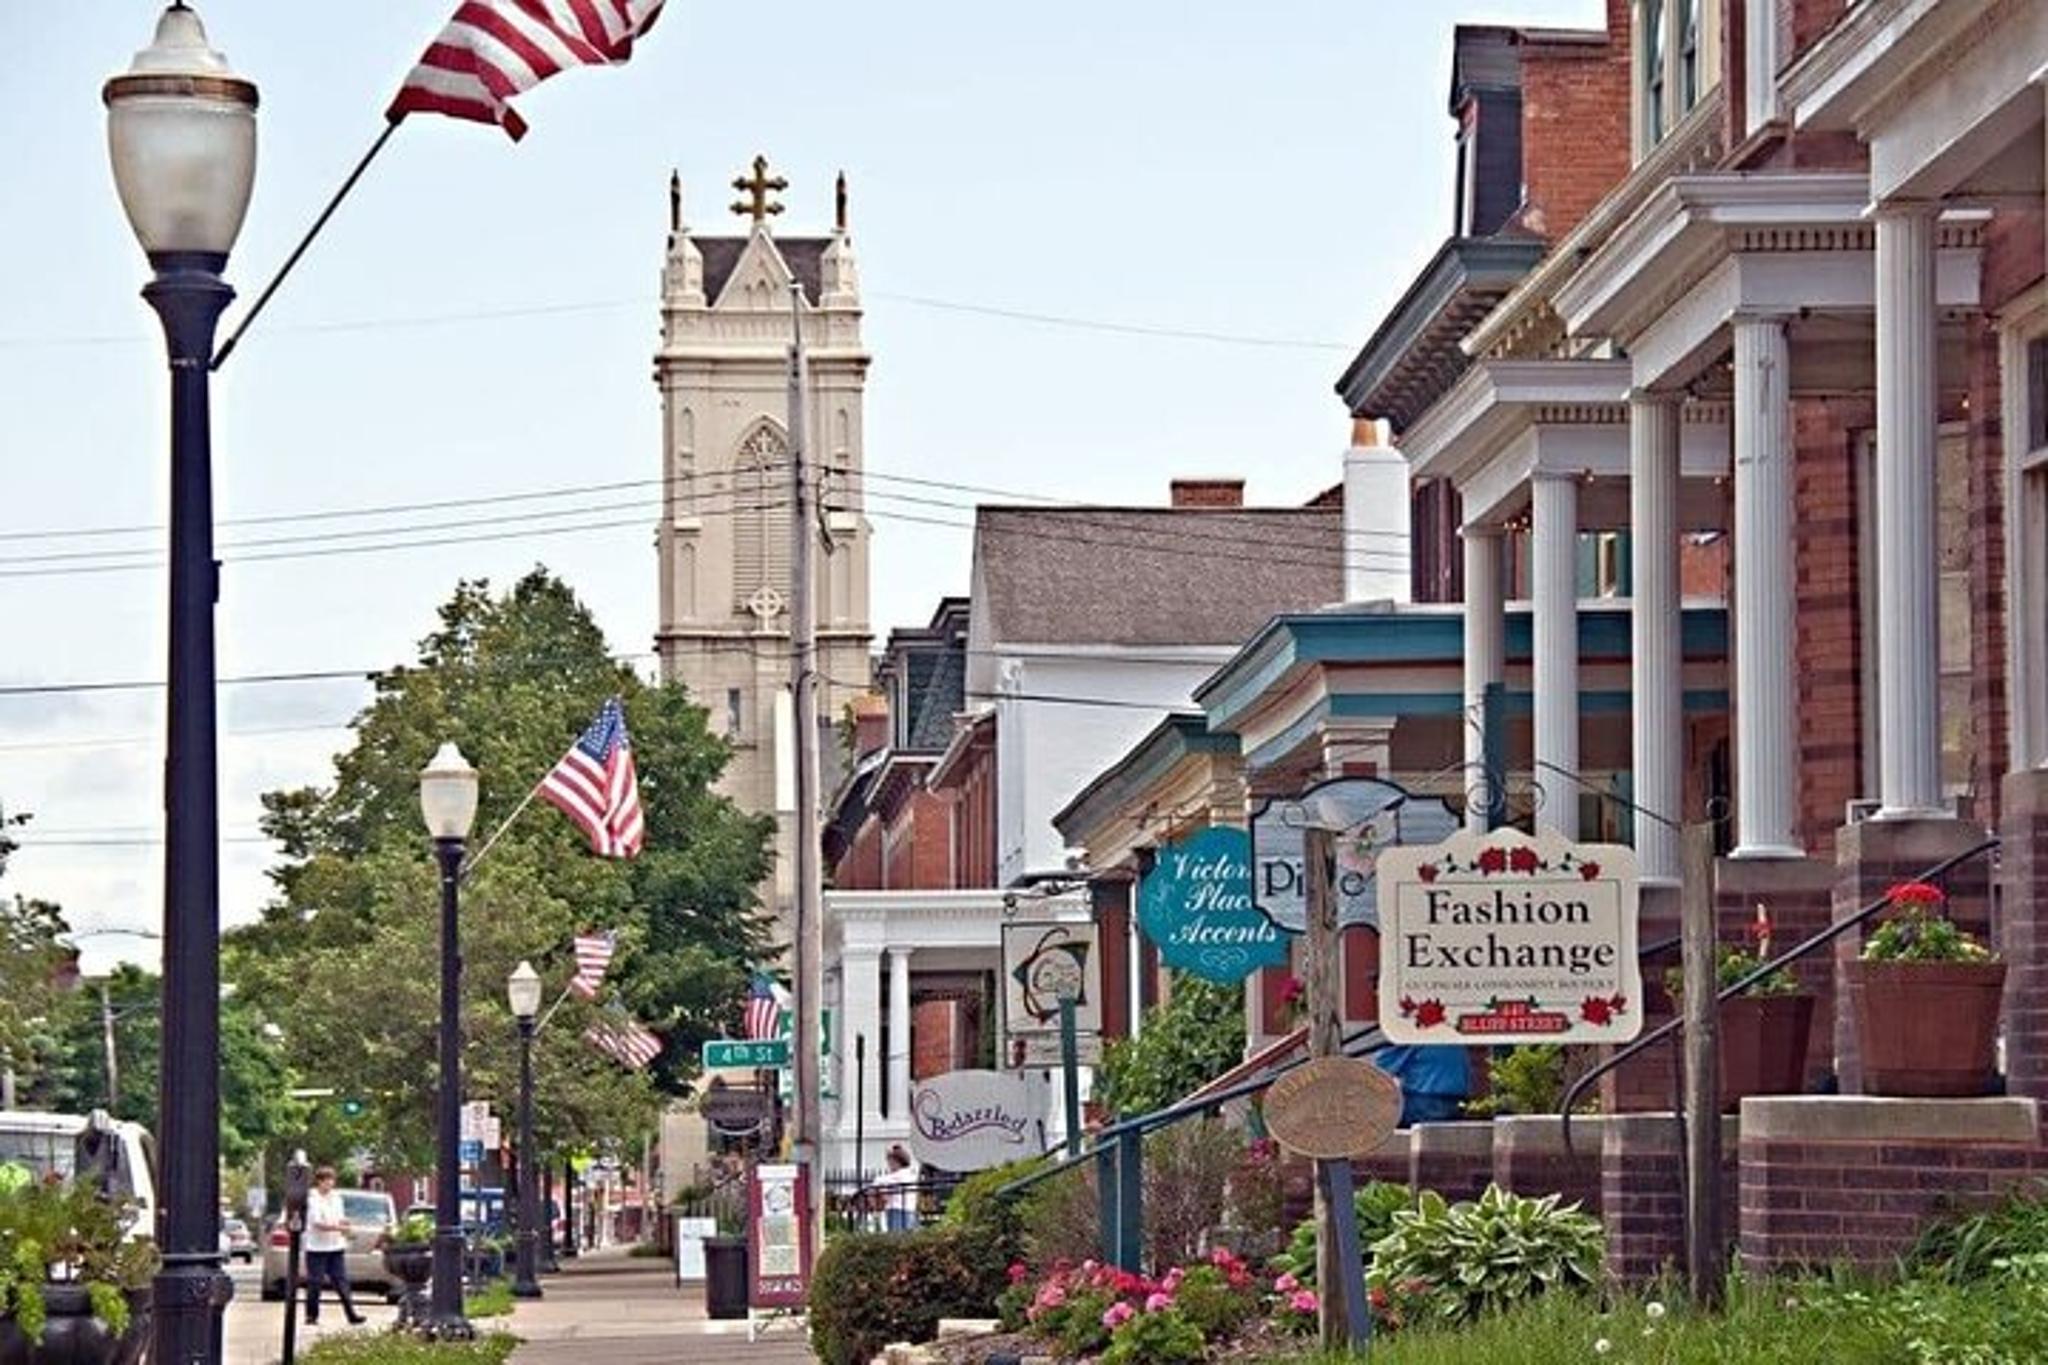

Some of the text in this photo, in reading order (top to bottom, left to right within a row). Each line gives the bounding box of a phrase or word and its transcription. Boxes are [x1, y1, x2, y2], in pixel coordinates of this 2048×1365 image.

[1174, 853, 1252, 880] Victor
[1185, 882, 1252, 911] Plac
[1426, 889, 1590, 925] Fashion
[1168, 915, 1277, 945] Accents
[1406, 932, 1614, 975] Exchange
[927, 1103, 1029, 1139] Bedazzled
